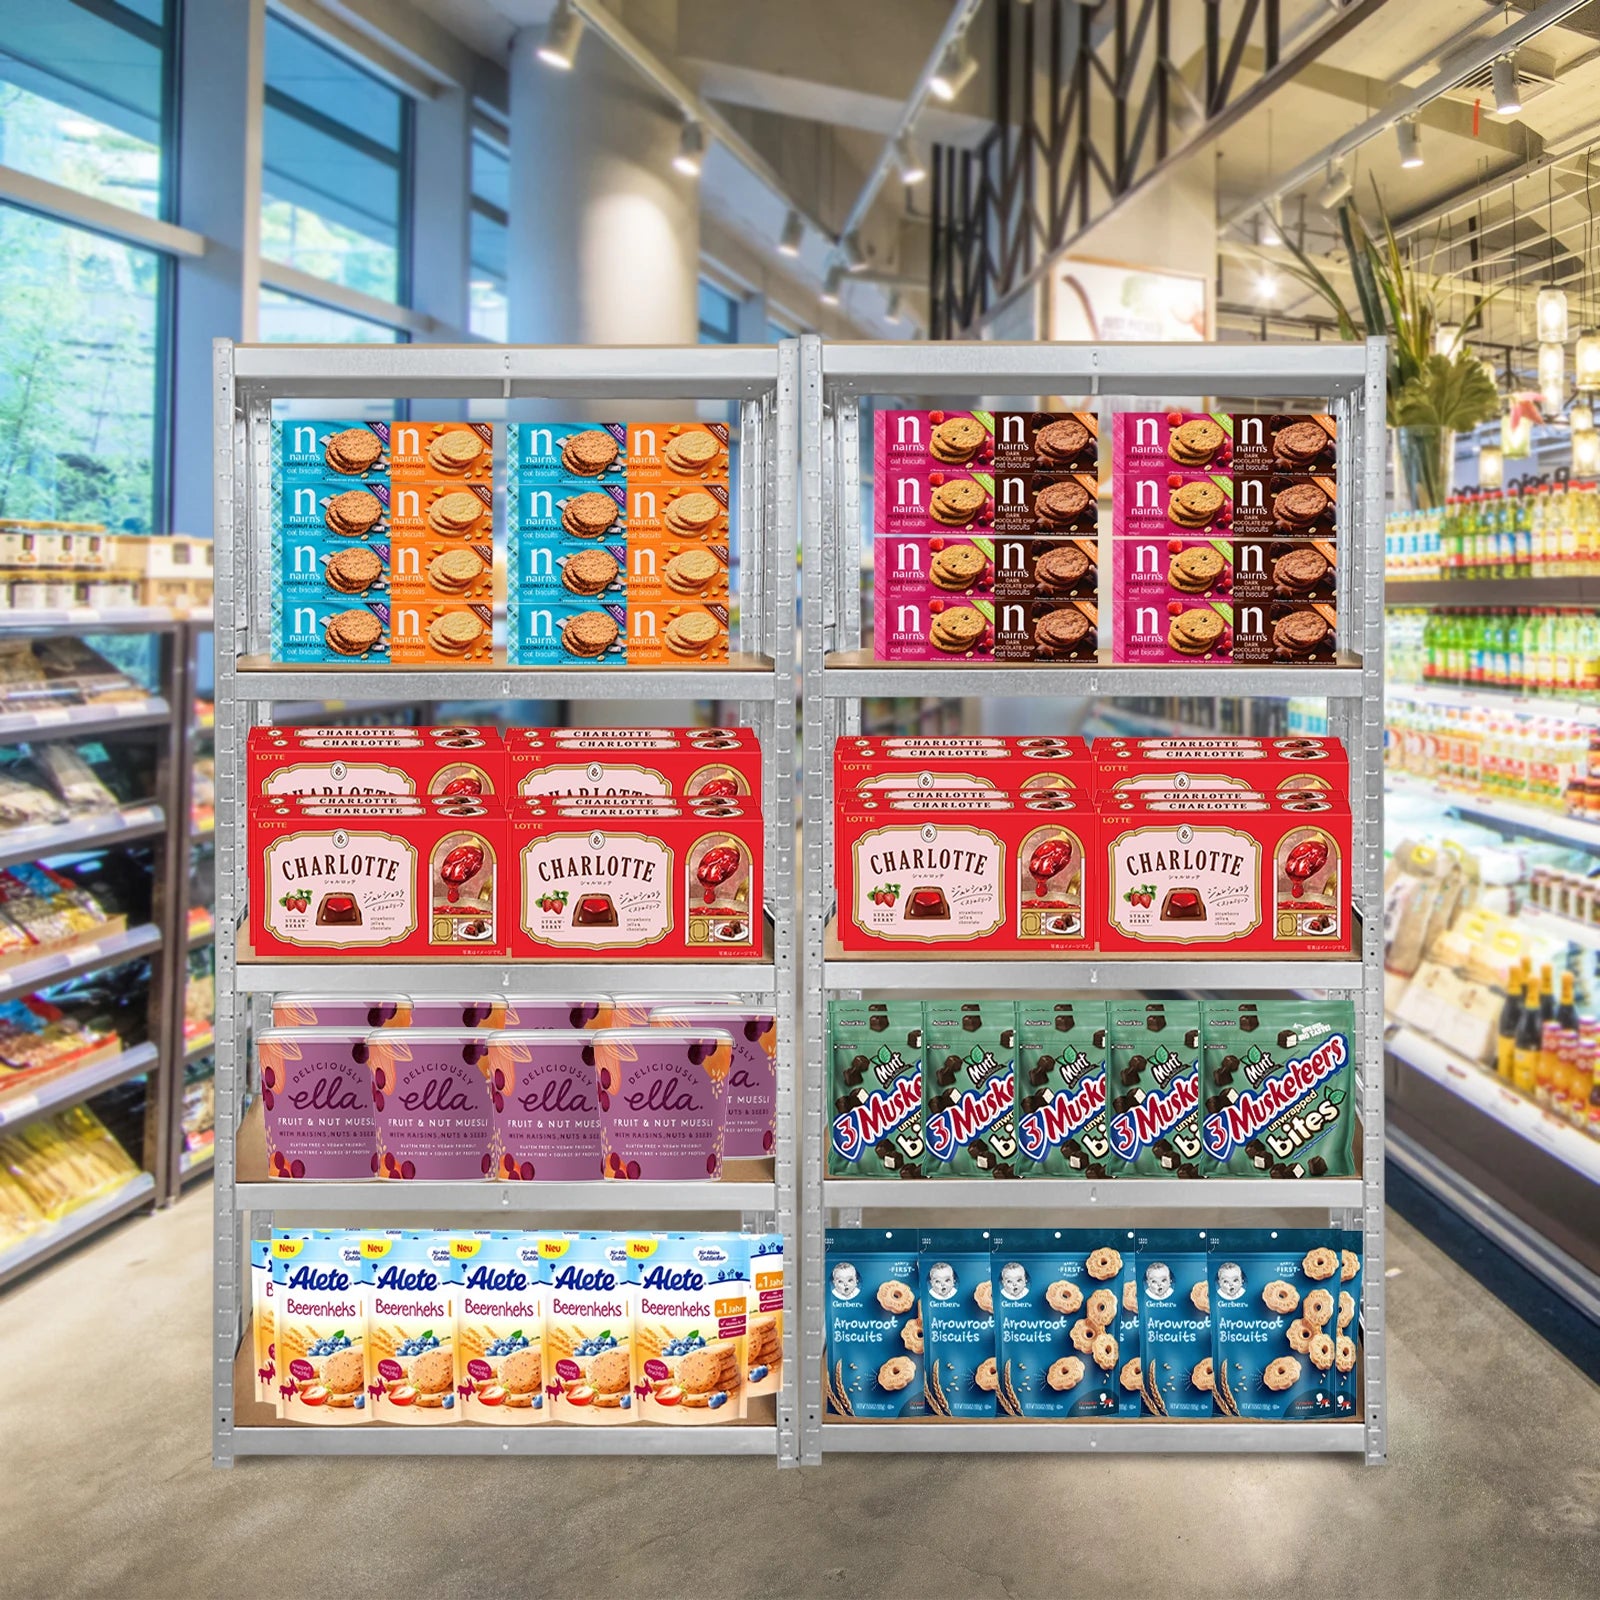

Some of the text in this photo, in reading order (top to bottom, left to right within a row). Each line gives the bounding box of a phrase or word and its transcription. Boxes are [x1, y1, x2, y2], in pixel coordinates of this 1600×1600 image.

[897, 415, 920, 443] n
[1003, 415, 1024, 443] n
[1136, 417, 1159, 445] n
[1242, 417, 1263, 445] n
[294, 426, 316, 453] n
[398, 428, 419, 455] n
[530, 428, 552, 455] n
[634, 429, 655, 456] n
[893, 443, 925, 451] nairn's
[997, 442, 1029, 451] nairn's
[1132, 445, 1164, 453] nairn's
[1236, 444, 1268, 453] nairn's
[289, 453, 320, 461] nairn's
[392, 455, 424, 463] nairn's
[525, 455, 556, 463] nairn's
[628, 456, 660, 464] nairn's
[282, 854, 400, 882] CHARLOTTE
[538, 855, 656, 883] CHARLOTTE
[870, 848, 988, 876] CHARLOTTE
[1126, 849, 1244, 877] CHARLOTTE
[292, 1062, 363, 1085] DELICIOUSLY
[403, 1063, 474, 1086] DELICIOUSLY
[522, 1064, 593, 1087] DELICIOUSLY
[628, 1063, 699, 1086] DELICIOUSLY
[875, 1052, 904, 1083] Mint
[968, 1052, 997, 1083] Mint
[1061, 1052, 1090, 1083] Mint
[1152, 1052, 1181, 1083] Mint
[1245, 1052, 1274, 1083] Mint
[1207, 1116, 1227, 1150] 3
[1228, 1038, 1343, 1141] Musketeers
[837, 1074, 921, 1150] 3 Muske
[930, 1074, 1014, 1150] 3 Muske
[1023, 1074, 1107, 1150] 3 Muske
[1114, 1074, 1198, 1150] 3 Muske
[1267, 1090, 1318, 1132] unwrapped
[277, 1118, 374, 1126] FRUIT & NUT MUESL
[388, 1119, 488, 1127] FRUIT & NUT MUESLI
[507, 1120, 600, 1128] FRUIT & NUT MUES
[613, 1119, 713, 1127] FRUIT & NUT MUESLI
[1267, 1100, 1338, 1157] bites
[279, 1244, 295, 1253] Neu
[367, 1244, 383, 1253] Neu
[456, 1244, 472, 1253] Neu
[545, 1244, 561, 1253] Neu
[633, 1244, 649, 1253] Neu
[289, 1266, 350, 1291] Alete
[377, 1266, 438, 1291] Alete
[466, 1266, 527, 1291] Alete
[555, 1266, 616, 1291] Alete
[643, 1266, 704, 1291] Alete
[762, 1276, 768, 1287] 1
[288, 1298, 356, 1317] Beerenkeks
[376, 1298, 444, 1317] Beerenkeks
[465, 1298, 533, 1317] Beerenkeks
[554, 1298, 622, 1317] Beerenkeks
[642, 1298, 710, 1317] Beerenkeks
[722, 1303, 743, 1314] 1 Jahr
[834, 1316, 899, 1330] Arrowroot
[931, 1316, 996, 1330] Arrowroot
[1003, 1316, 1068, 1330] Arrowroot
[1147, 1316, 1212, 1330] Arrowroot
[1219, 1316, 1284, 1330] Arrowroot
[835, 1331, 883, 1343] Biscuits
[932, 1331, 980, 1343] Biscuits
[1004, 1331, 1052, 1343] Biscuits
[1148, 1331, 1196, 1343] Biscuits
[1220, 1331, 1268, 1343] Biscuits
